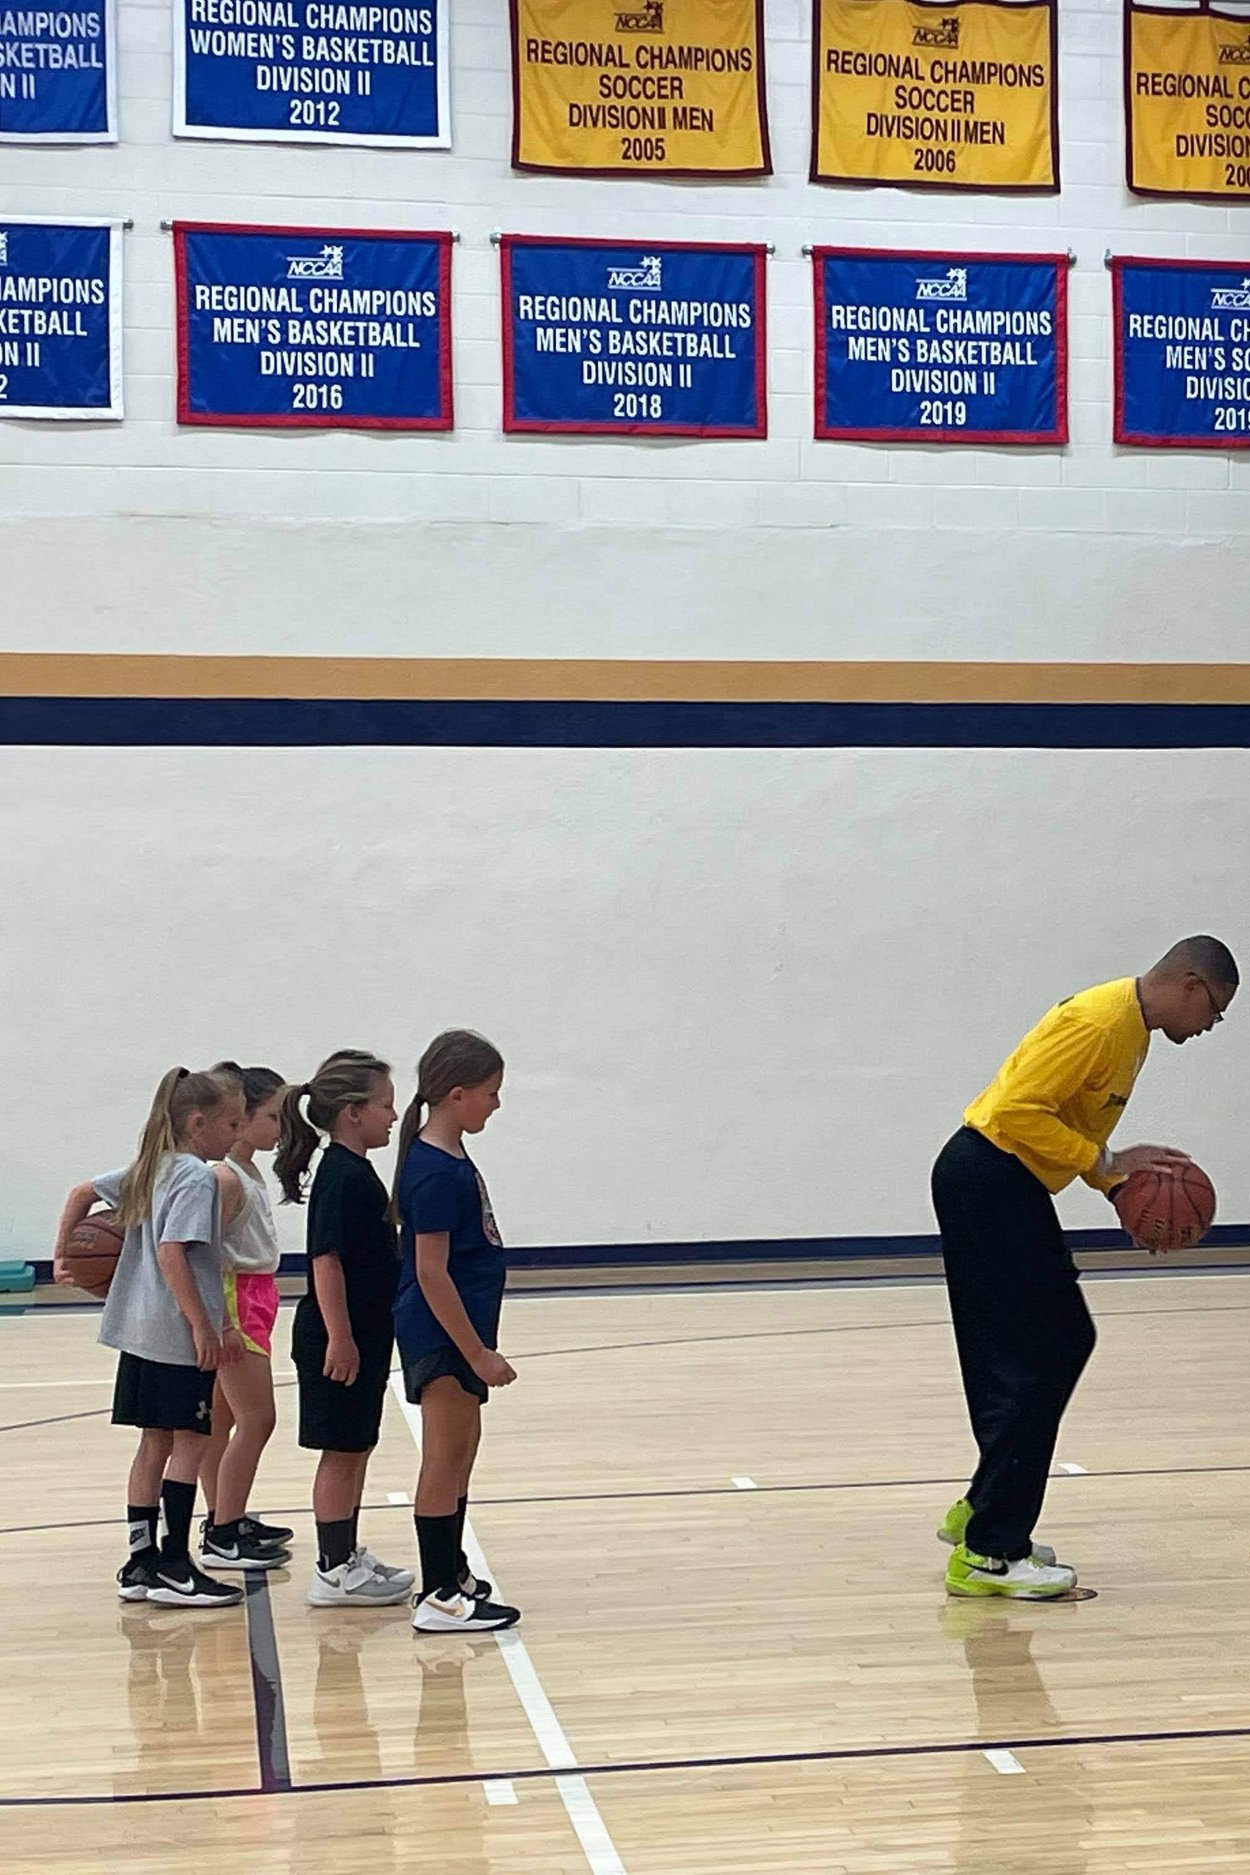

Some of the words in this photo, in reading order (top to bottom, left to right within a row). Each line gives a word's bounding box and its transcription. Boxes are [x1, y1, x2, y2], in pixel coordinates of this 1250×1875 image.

[0, 10, 100, 38] AMPIONS
[192, 0, 299, 28] REGIONAL
[306, 4, 433, 35] CHAMPIONS
[190, 29, 295, 60] WOMEN'S
[302, 36, 434, 66] BASKETBALL
[527, 39, 630, 68] REGIONAL
[635, 45, 752, 72] CHAMPIONS
[257, 65, 350, 94] DIVISION
[358, 70, 371, 95] II
[826, 49, 925, 81] REGIONAL
[930, 60, 1045, 87] CHAMPIONS
[22, 73, 35, 99] II
[599, 74, 683, 100] SOCCER
[895, 85, 974, 114] SOCCER
[1136, 72, 1233, 99] REGIONAL
[289, 99, 340, 126] 2012
[569, 103, 657, 130] DIVISION
[673, 106, 714, 132] MEN
[866, 113, 948, 142] DIVISION
[951, 119, 961, 142] II
[964, 120, 1005, 145] MEN
[621, 138, 666, 161] 2005
[914, 149, 956, 172] 2006
[0, 276, 105, 305] AMPIONS
[195, 285, 303, 313] REGIONAL
[309, 288, 436, 317] CHAMPIONS
[519, 295, 623, 323] REGIONAL
[628, 299, 751, 328] CHAMPIONS
[832, 305, 931, 333] REGIONAL
[936, 309, 1052, 336] CHAMPIONS
[213, 317, 281, 345] MEN'S
[288, 321, 421, 348] BASKETBALL
[1129, 313, 1225, 342] REGIONAL
[26, 342, 40, 367] II
[536, 327, 602, 354] MEN'S
[608, 330, 736, 358] BASKETBALL
[848, 336, 910, 363] MEN'S
[916, 339, 1038, 366] BASKETBALL
[260, 351, 354, 377] DIVISION
[361, 353, 375, 377] II
[1166, 346, 1226, 371] MEN'S
[582, 360, 672, 387] DIVISION
[679, 364, 692, 388] II
[891, 368, 977, 395] DIVISION
[983, 371, 995, 395] II
[292, 384, 343, 409] 2016
[613, 393, 662, 419] 2018
[920, 401, 966, 425] 2019
